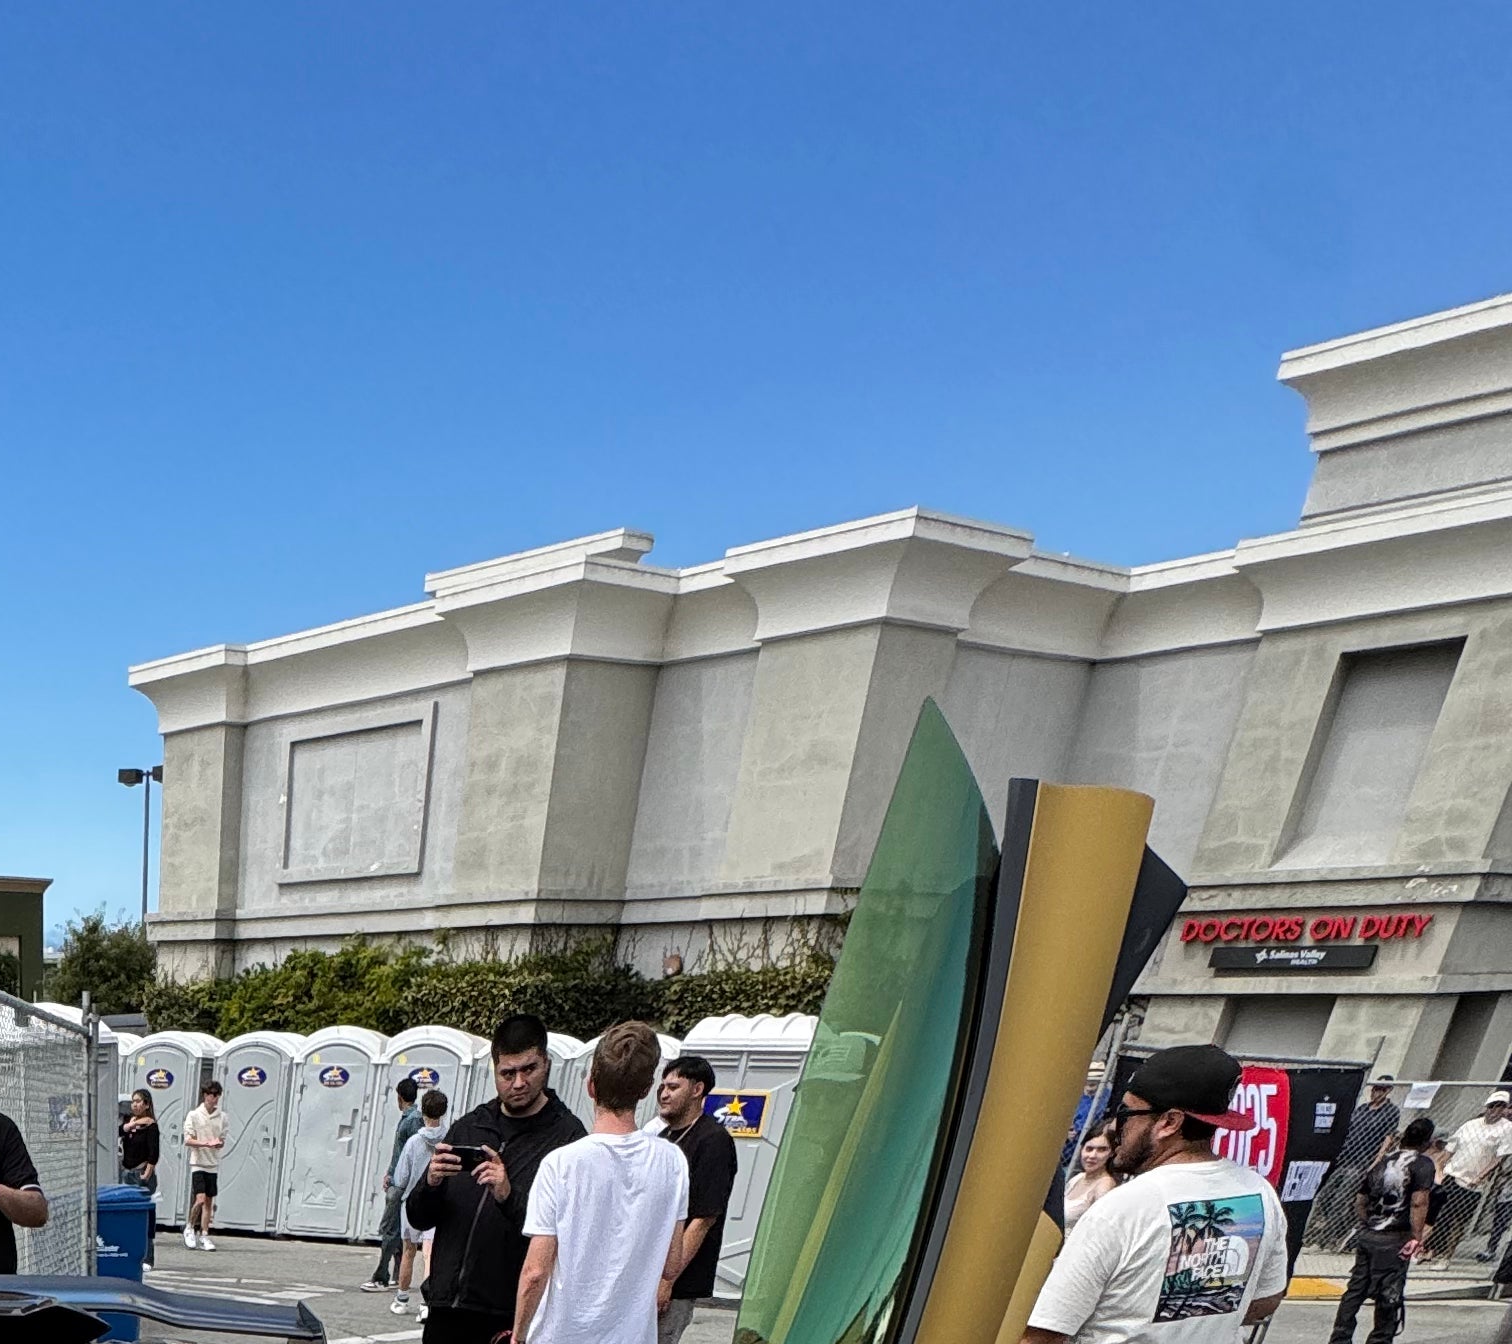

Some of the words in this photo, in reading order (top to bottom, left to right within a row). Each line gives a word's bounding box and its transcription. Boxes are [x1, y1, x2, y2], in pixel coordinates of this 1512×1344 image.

[1180, 916, 1303, 942] DOCTORS
[1309, 916, 1356, 941] ON
[1358, 914, 1433, 940] DUTY
[1203, 1235, 1230, 1253] THE
[1178, 1250, 1227, 1273] NORTH
[1191, 1264, 1226, 1282] FACE
